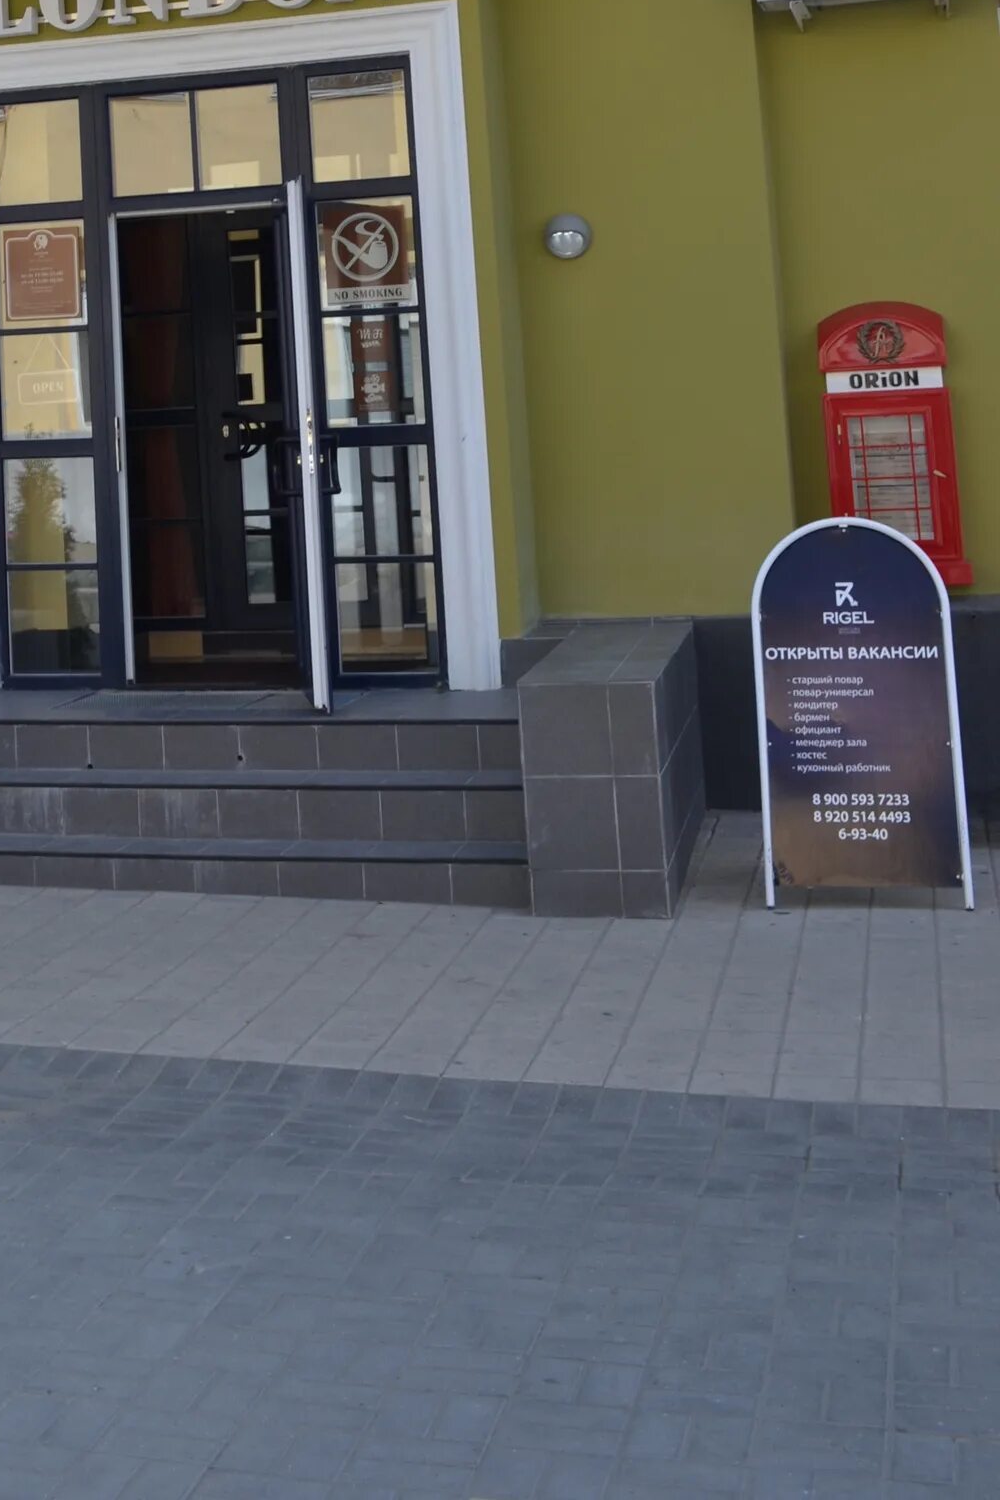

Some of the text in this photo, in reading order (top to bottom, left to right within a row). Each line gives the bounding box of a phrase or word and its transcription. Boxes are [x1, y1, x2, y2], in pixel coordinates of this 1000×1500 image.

[334, 288, 403, 301] NO SMOKING
[32, 381, 64, 394] OPEN
[823, 611, 875, 625] RIGEL
[765, 645, 939, 661] ОТКРЫТЫ ВАКАНСИИ
[792, 675, 864, 686] старший повар
[792, 688, 875, 699] повар-универсал
[793, 701, 839, 711] кондитер
[794, 712, 830, 723] бармен
[795, 724, 842, 736] официант
[795, 739, 868, 749] менеджер зала
[796, 751, 828, 760] хостес
[797, 762, 892, 774] кухонный работник
[812, 793, 910, 807] 8 900 593 7233
[813, 810, 912, 824] 8 920 514 4493
[838, 827, 889, 841] 6-93-40
